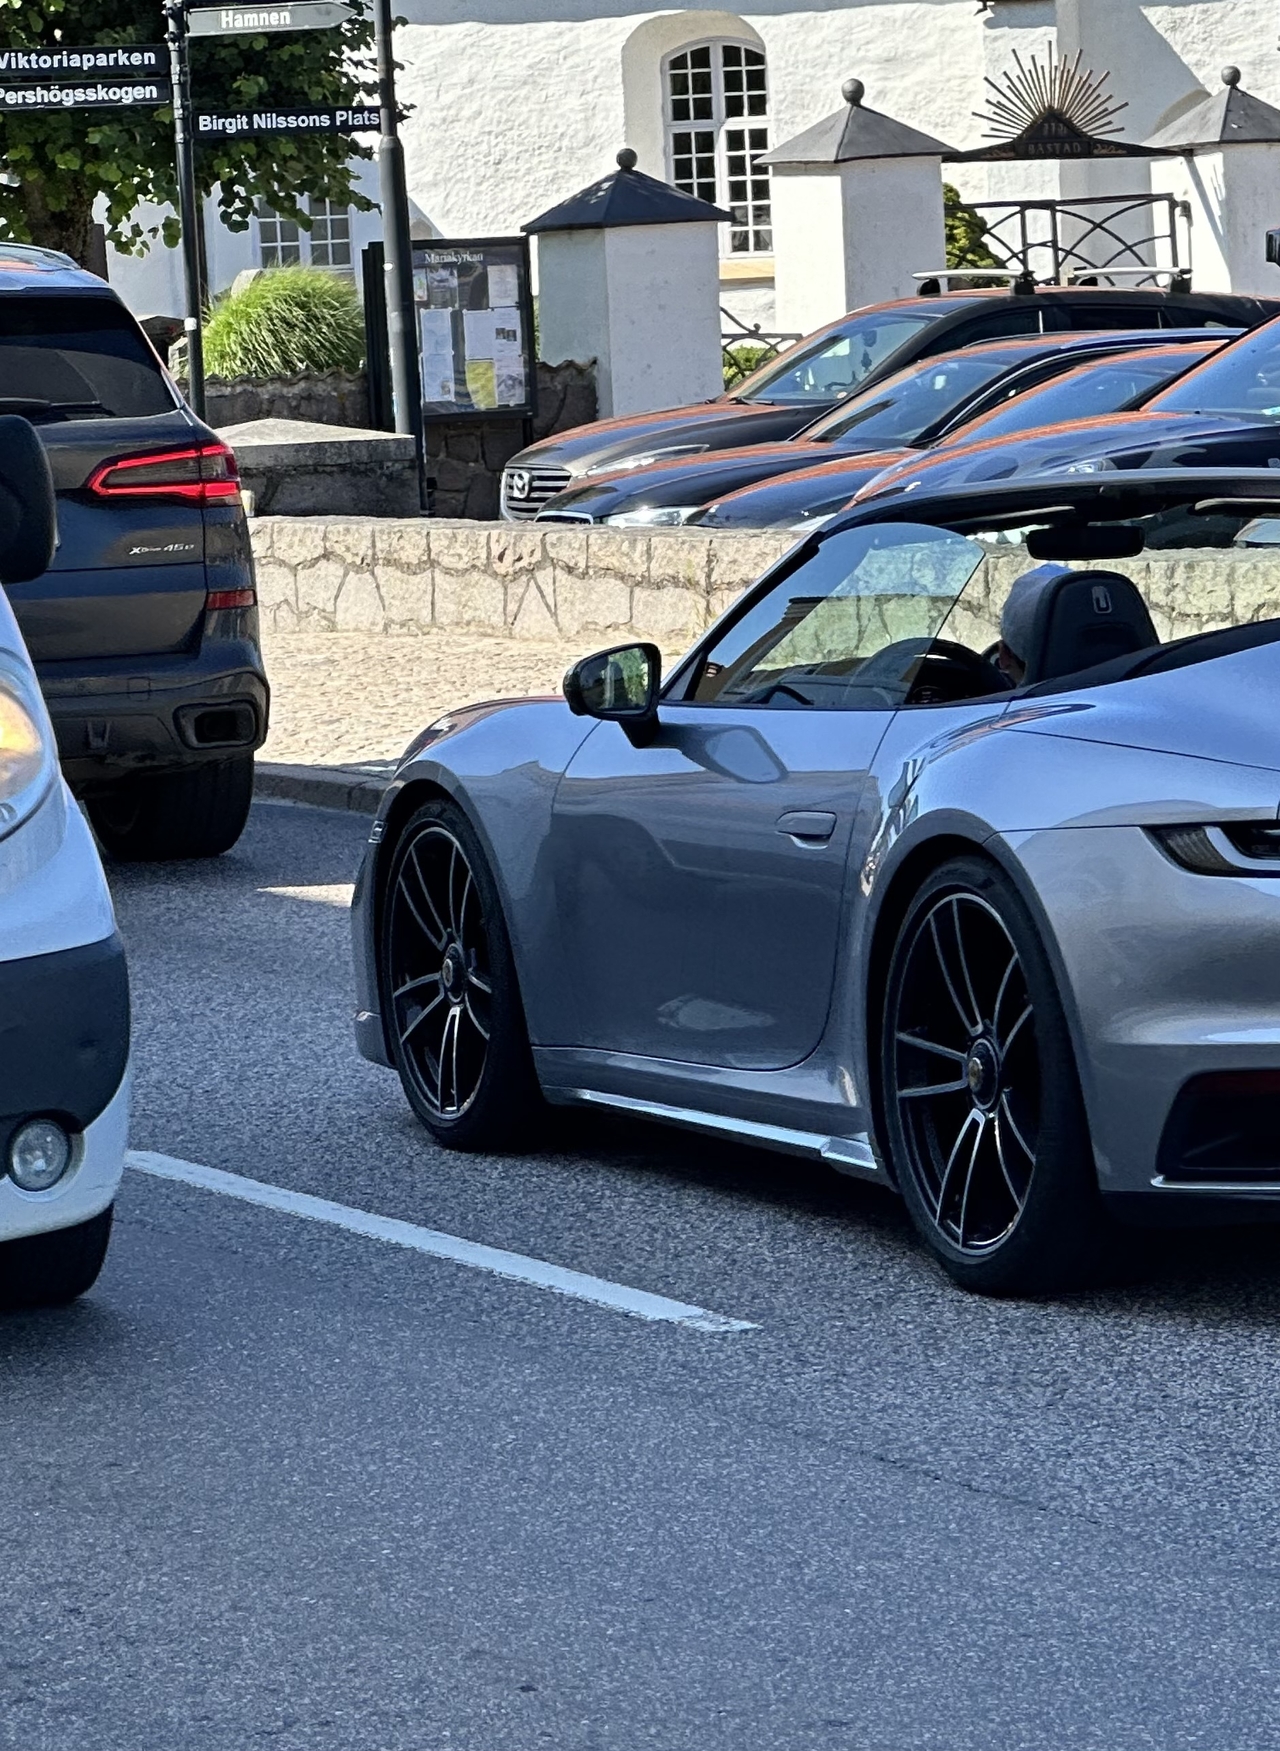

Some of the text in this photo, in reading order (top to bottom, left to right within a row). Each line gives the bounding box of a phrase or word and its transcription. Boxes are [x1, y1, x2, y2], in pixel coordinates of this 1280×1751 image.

[220, 10, 291, 28] Hamnen
[198, 110, 380, 134] Birgit Nilssons Plats
[424, 250, 484, 265] Mariakyrkan
